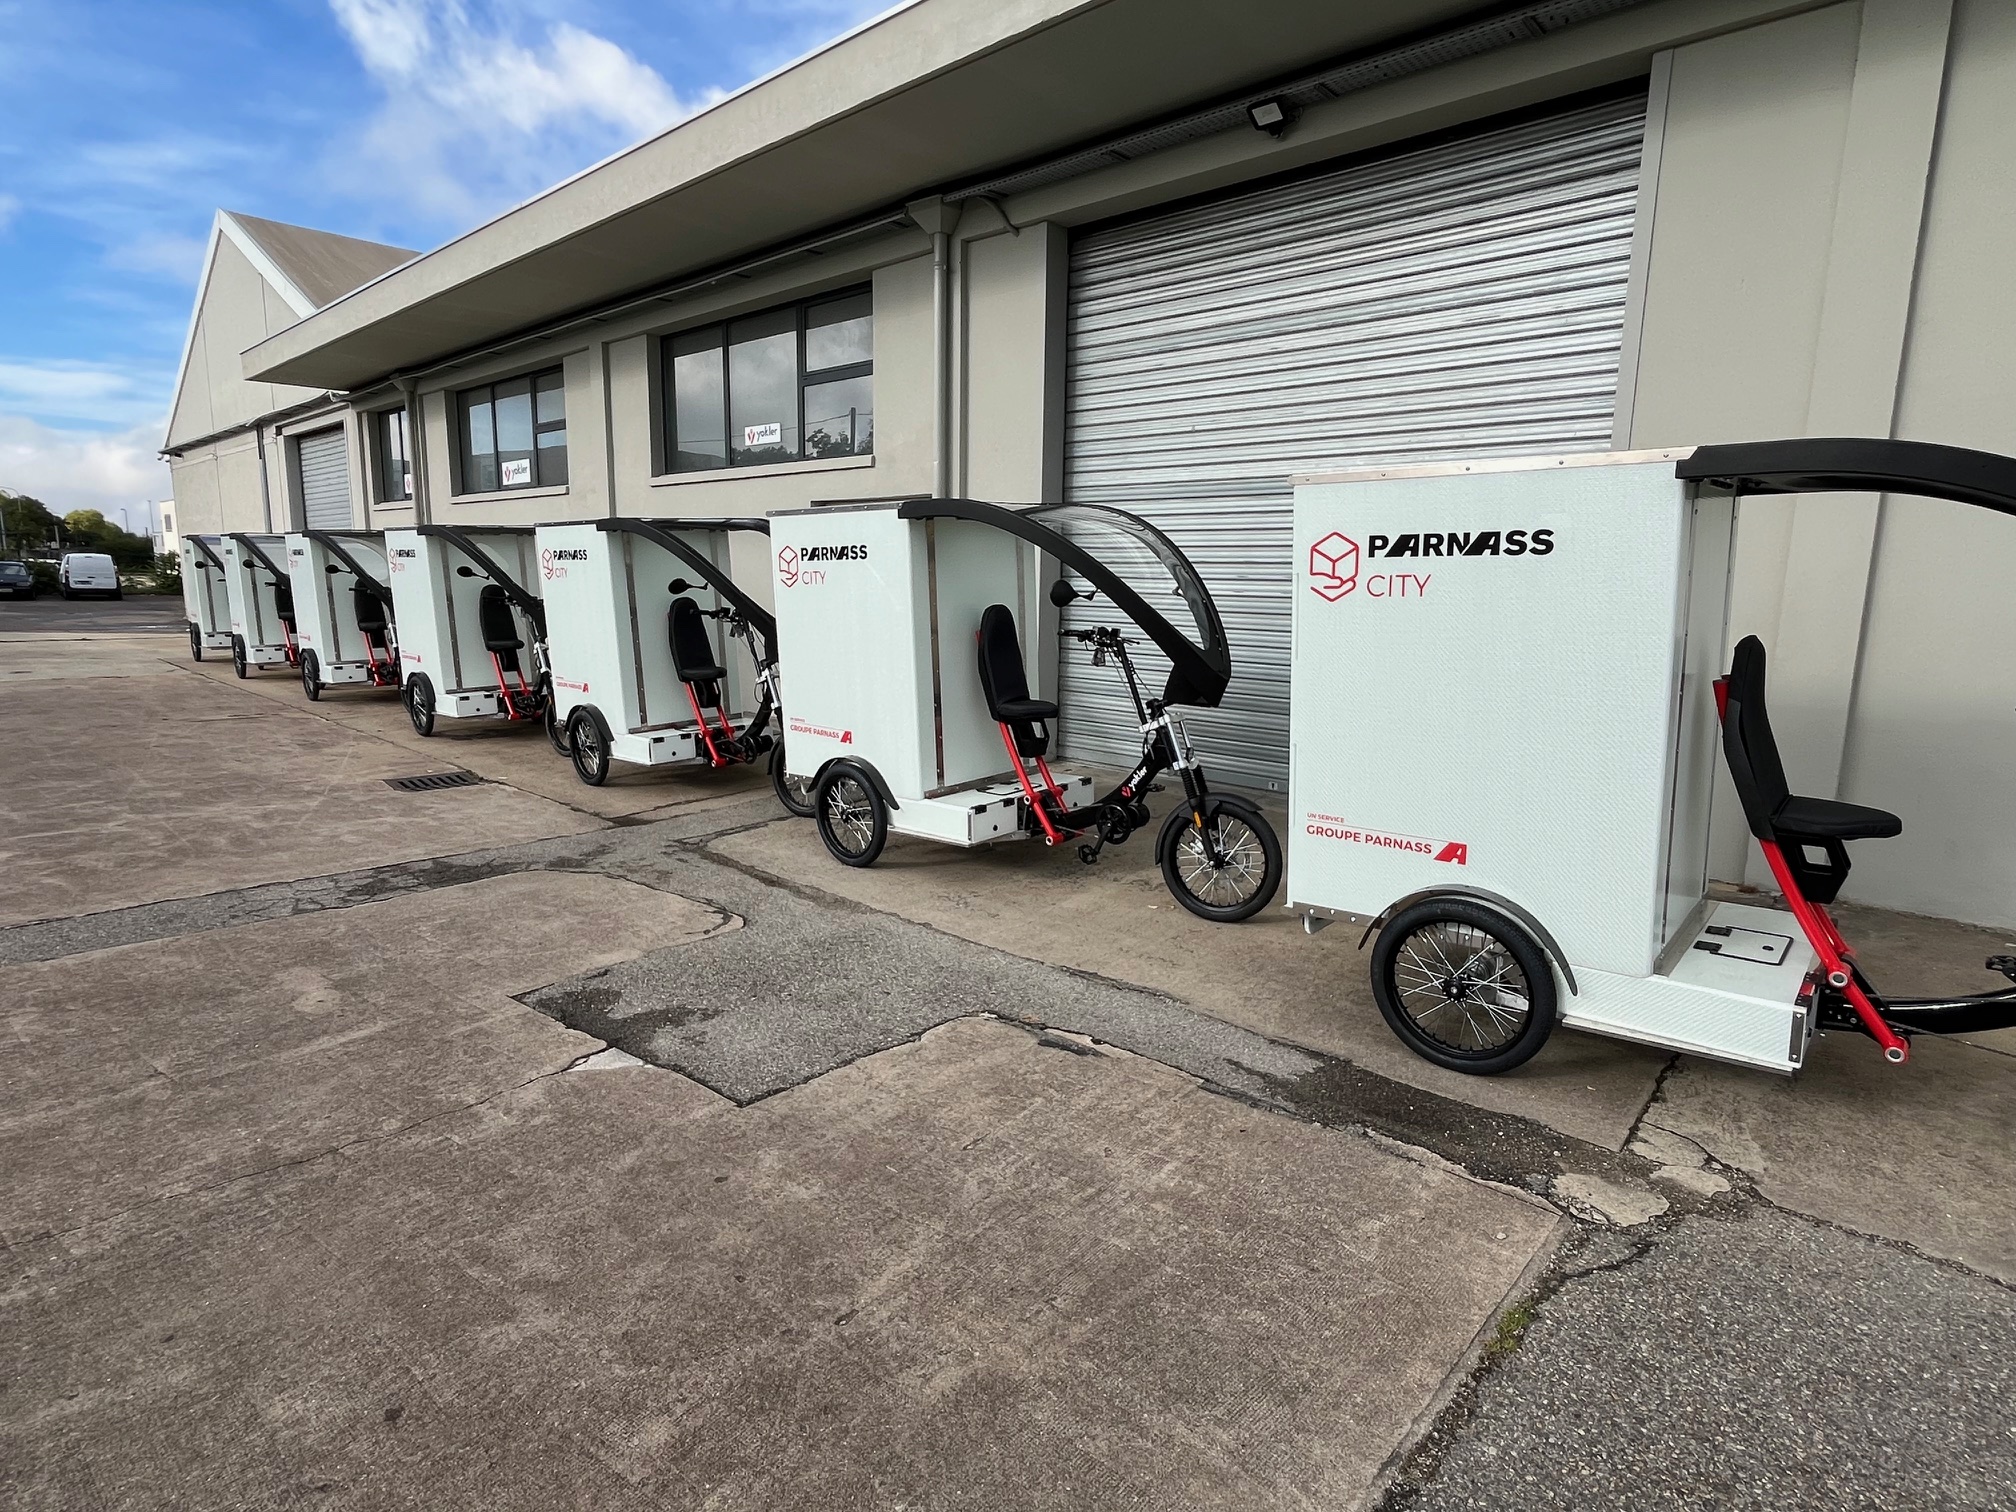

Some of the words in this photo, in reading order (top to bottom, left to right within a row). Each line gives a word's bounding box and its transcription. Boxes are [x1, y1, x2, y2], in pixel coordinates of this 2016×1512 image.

[756, 425, 778, 443] yokler
[1367, 529, 1555, 558] PARNASS
[553, 549, 588, 561] PARNASS
[800, 545, 867, 561] PARNASS
[801, 570, 826, 585] CITY
[1366, 573, 1432, 598] CITY
[1128, 766, 1147, 791] yokler
[1318, 814, 1344, 823] SERVICE
[1306, 825, 1361, 842] GROUPE
[1365, 834, 1432, 854] PARNASS
